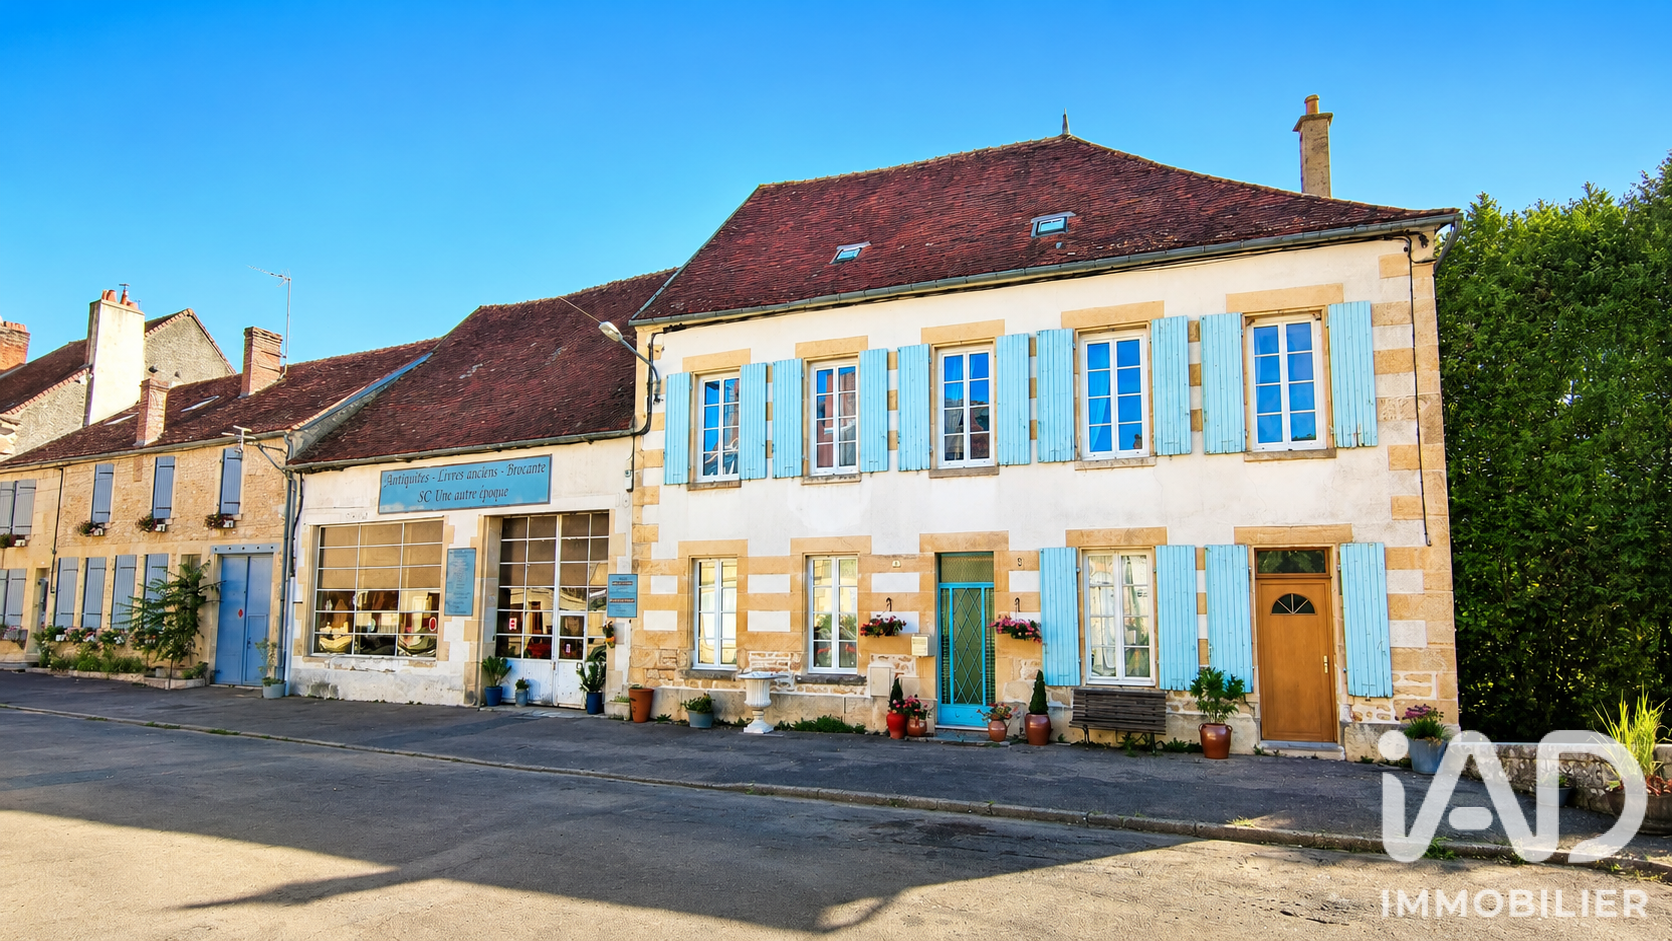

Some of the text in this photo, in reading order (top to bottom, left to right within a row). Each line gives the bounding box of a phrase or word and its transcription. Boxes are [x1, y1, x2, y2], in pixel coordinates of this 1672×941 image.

[437, 468, 464, 482] Livres
[466, 466, 498, 480] anciens
[506, 463, 546, 476] Brocante
[417, 485, 509, 503] SC Une autre époque
